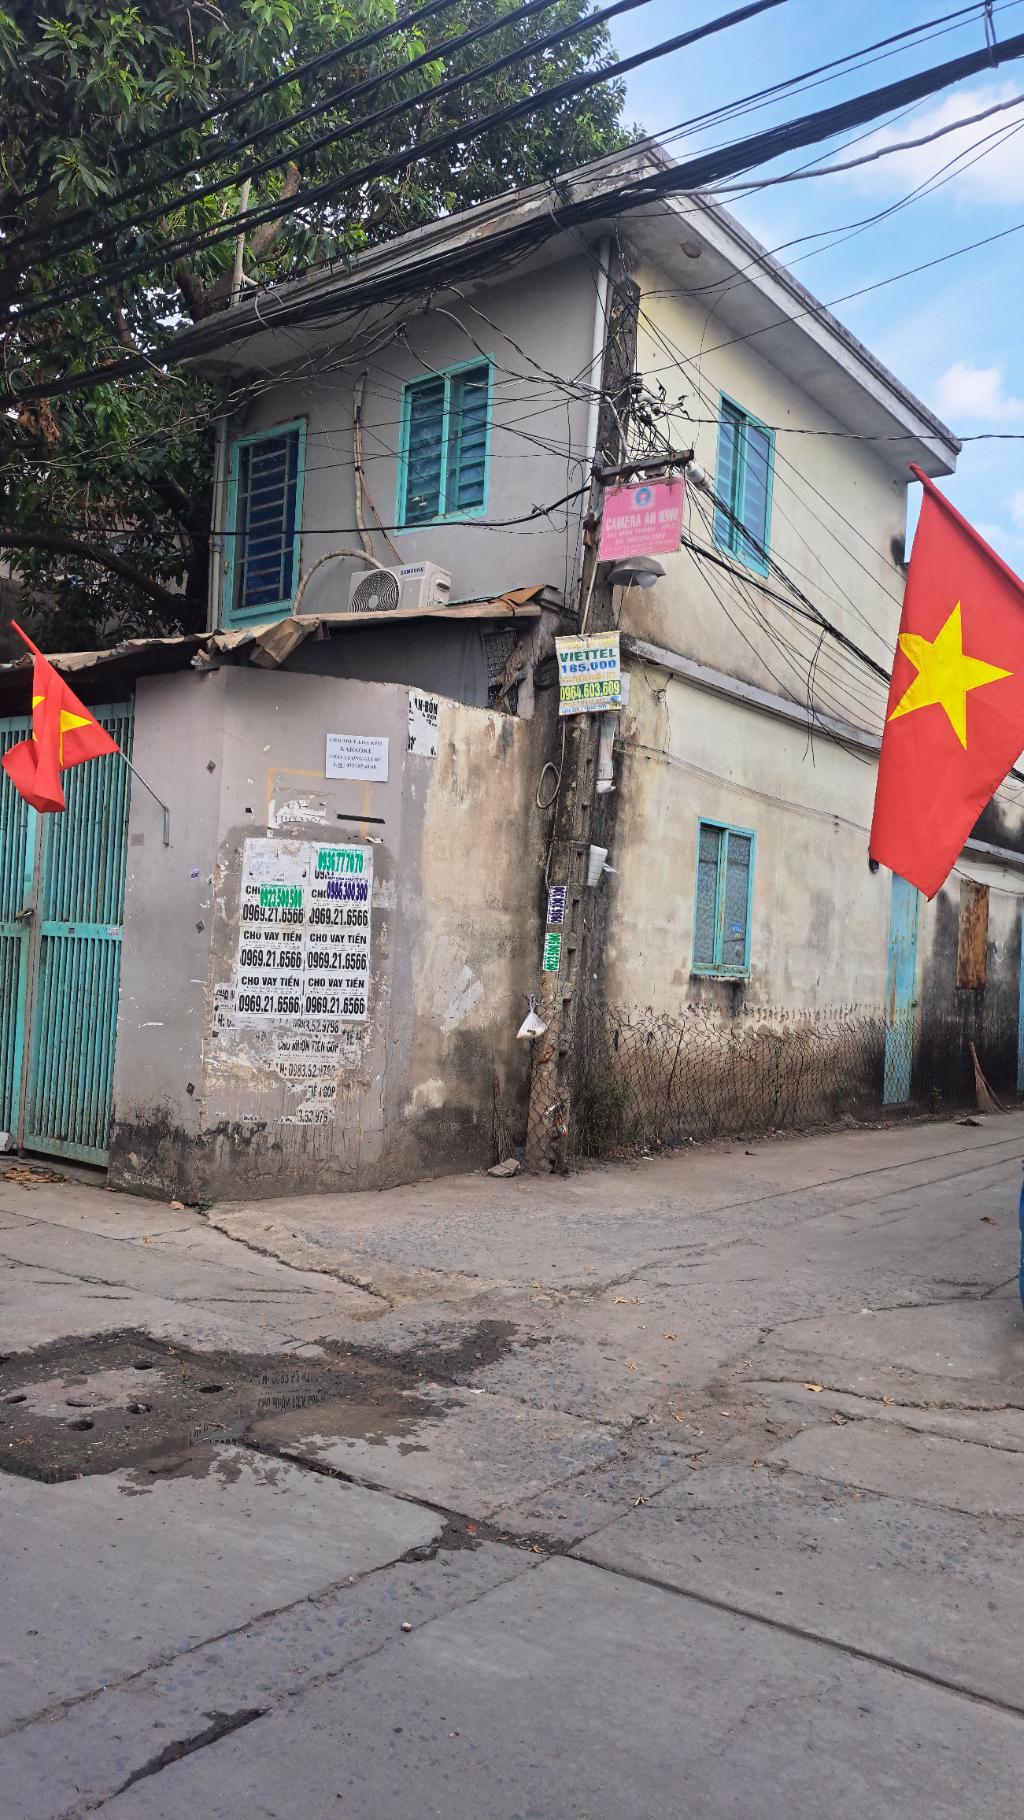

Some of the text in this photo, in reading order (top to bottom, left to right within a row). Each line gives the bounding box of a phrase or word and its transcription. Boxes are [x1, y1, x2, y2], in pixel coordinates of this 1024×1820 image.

[605, 513, 641, 531] CAMERA
[644, 511, 657, 526] AN
[400, 567, 424, 575] SAMSUNG
[560, 649, 616, 662] VIETTEL
[561, 659, 616, 673] 185.000
[309, 907, 368, 926] 0969.21.6566
[264, 932, 280, 941] VAY
[310, 933, 328, 943] CHO
[330, 934, 346, 943] VAY
[241, 948, 302, 968] 0969.21.6566
[307, 951, 367, 971] 0969.21.6566
[241, 976, 260, 986] CHO
[262, 977, 278, 986] VAY
[308, 977, 326, 987] CHO
[328, 979, 344, 988] VAY
[239, 994, 300, 1014] 0969.21.6566
[305, 996, 366, 1015] 0969.21.6566
